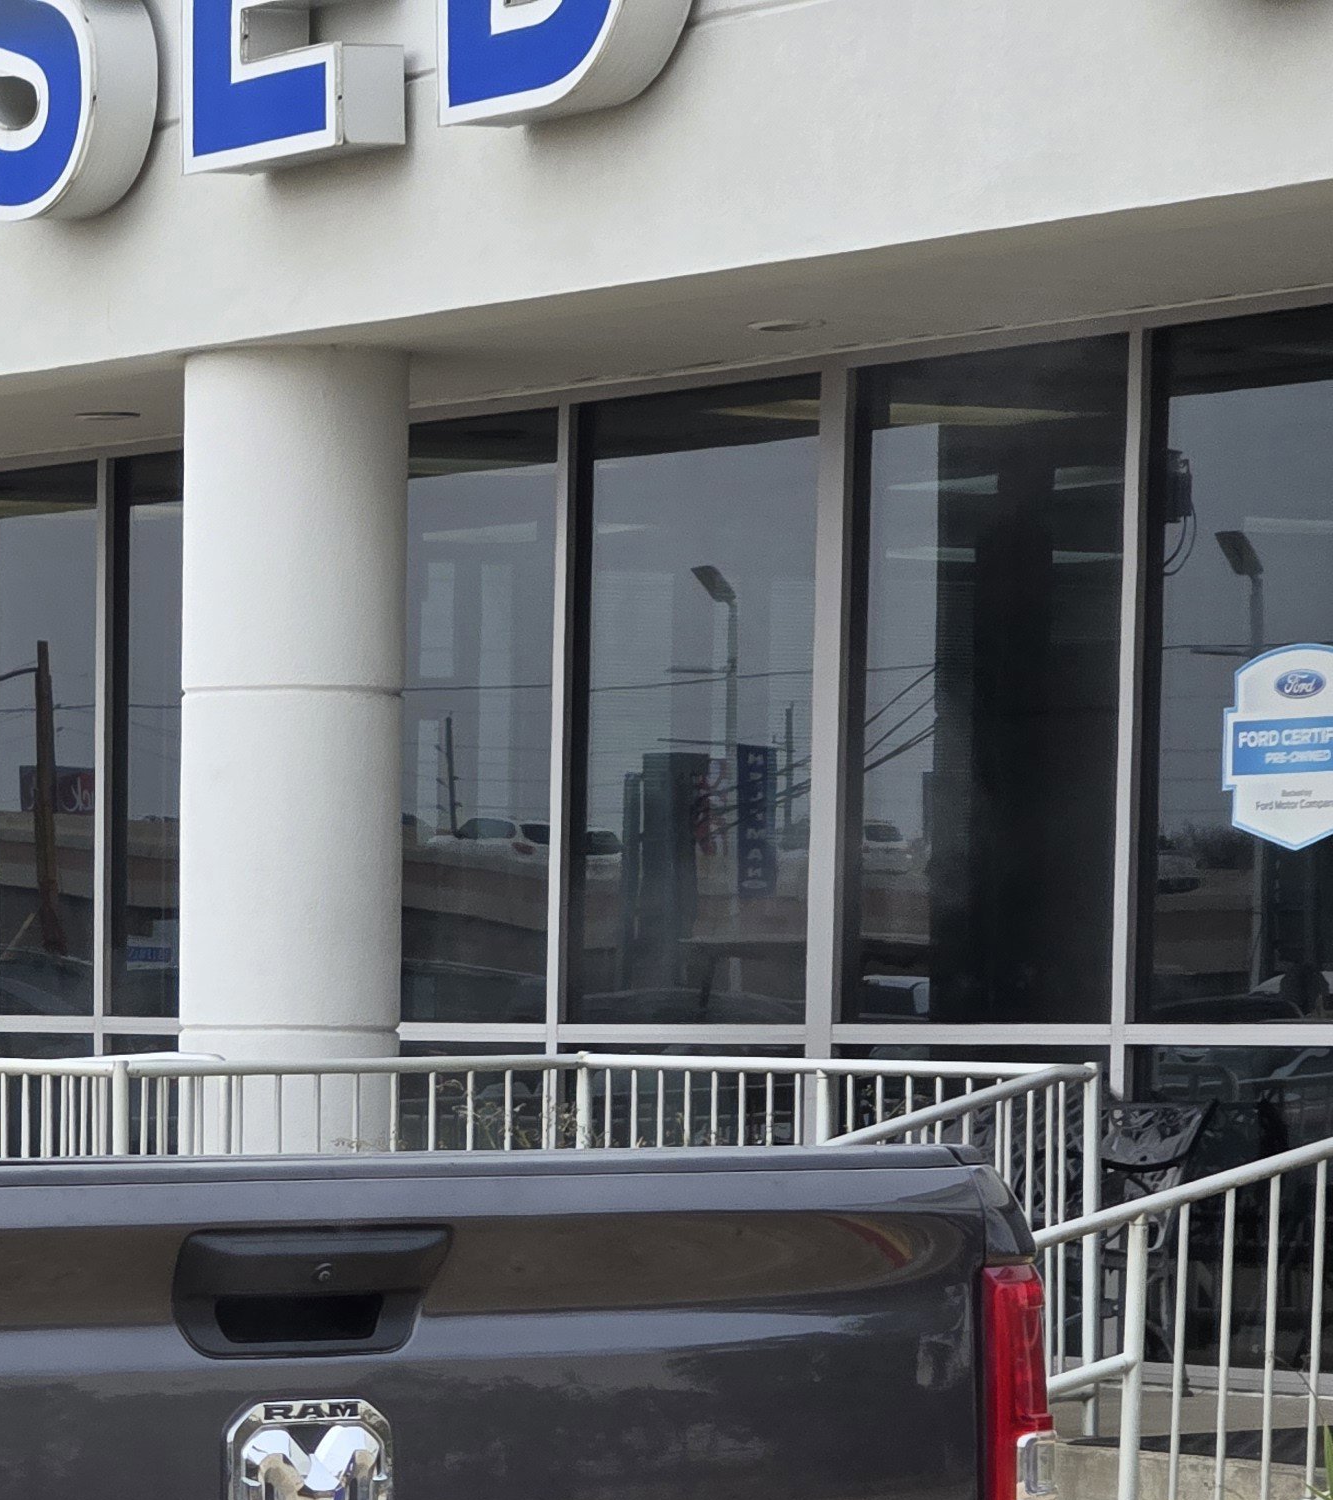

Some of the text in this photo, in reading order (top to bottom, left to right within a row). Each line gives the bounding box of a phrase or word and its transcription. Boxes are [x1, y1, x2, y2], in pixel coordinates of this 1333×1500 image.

[1283, 672, 1317, 694] Ford
[1238, 729, 1280, 748] FORD
[263, 1403, 359, 1421] RAM
